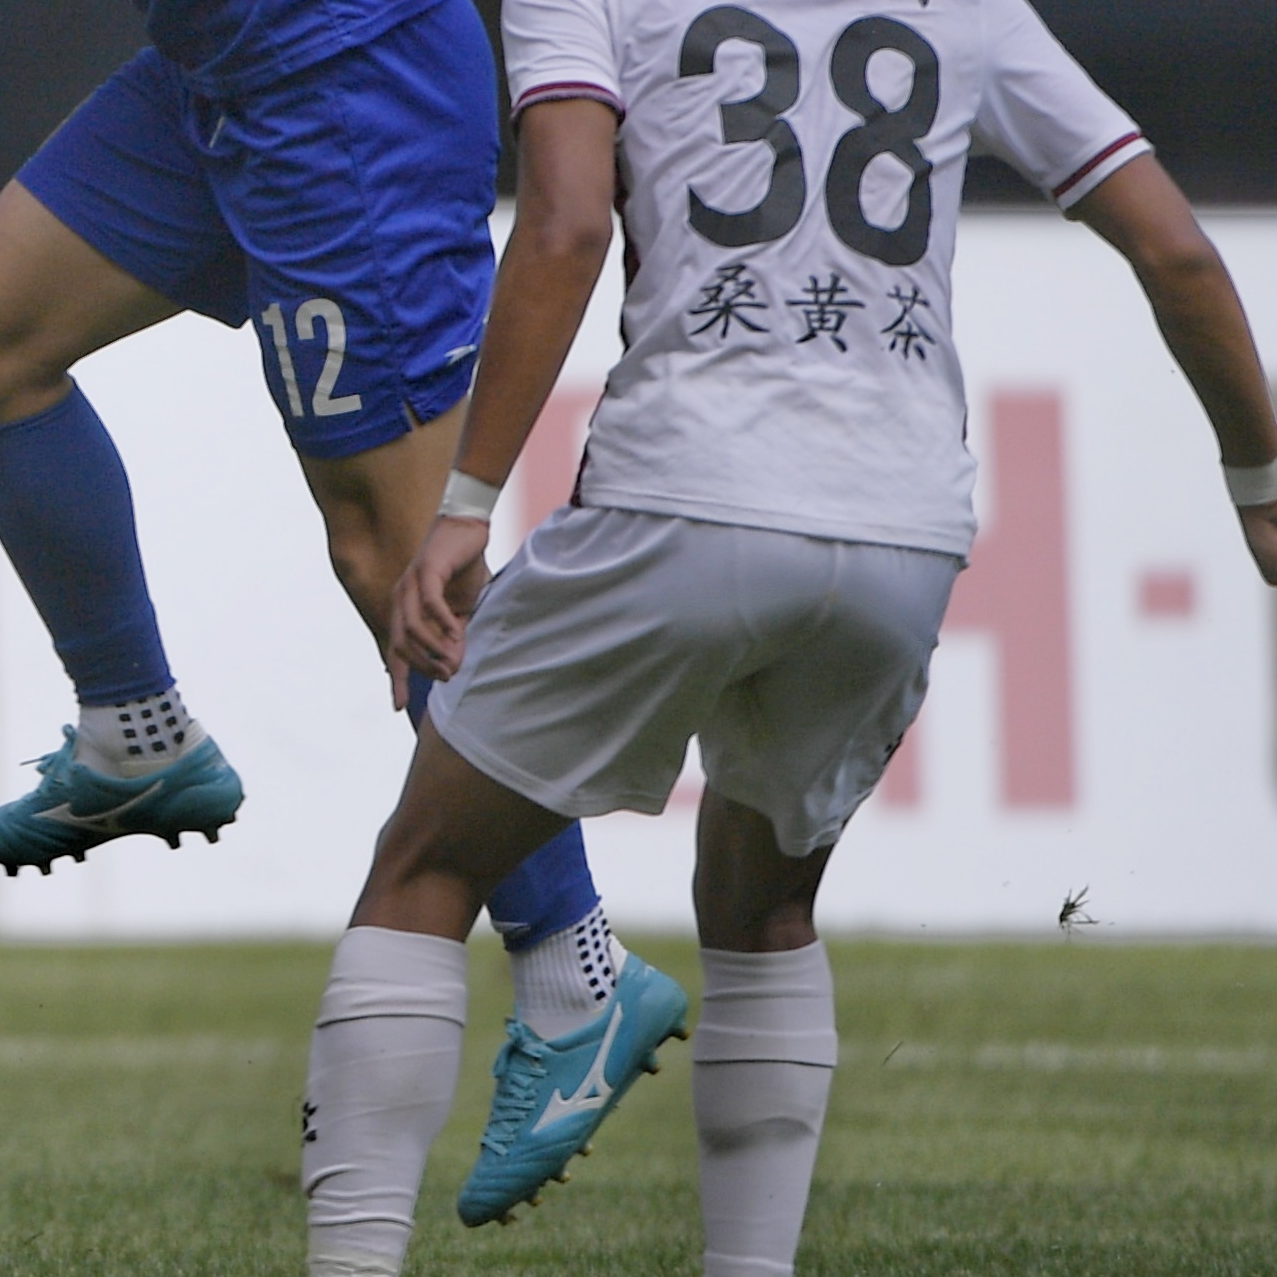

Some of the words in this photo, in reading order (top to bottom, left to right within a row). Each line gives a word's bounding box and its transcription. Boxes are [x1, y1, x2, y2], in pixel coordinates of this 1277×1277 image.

[677, 3, 941, 268] 38
[261, 297, 363, 417] 12
[688, 264, 937, 361] 桑黄茶
